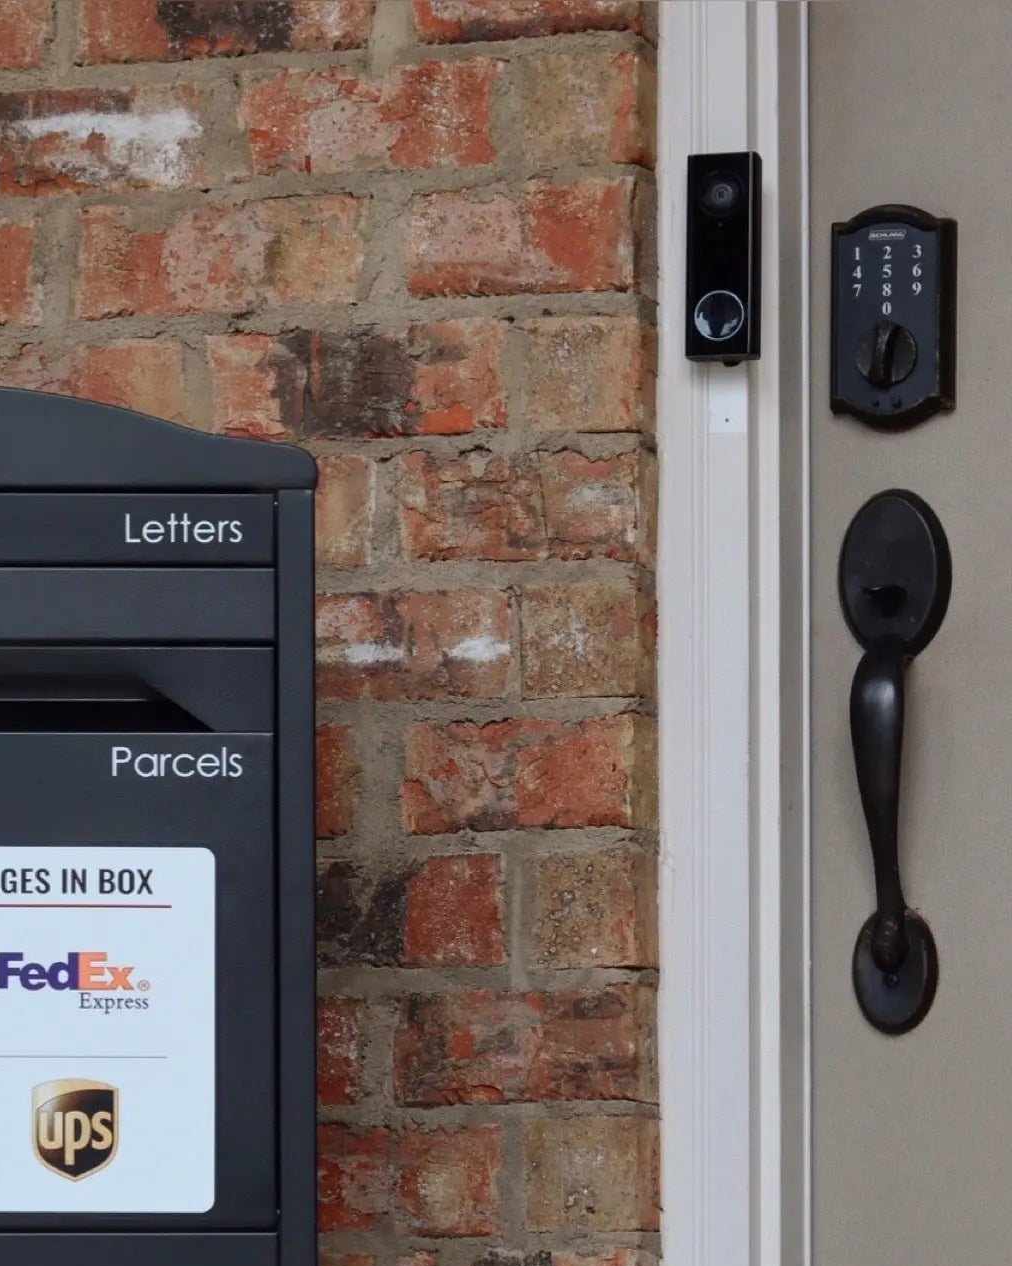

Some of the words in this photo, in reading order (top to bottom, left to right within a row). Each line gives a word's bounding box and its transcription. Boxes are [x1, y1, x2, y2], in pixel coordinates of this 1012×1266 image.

[855, 247, 860, 260] 1
[882, 246, 892, 259] 2
[912, 244, 922, 259] 3
[852, 265, 862, 279] 4
[882, 264, 892, 278] 5
[912, 262, 922, 277] 6
[852, 284, 862, 297] 7
[882, 283, 892, 296] 8
[912, 282, 922, 296] 9
[882, 302, 892, 315] 0
[124, 513, 243, 543] Letters
[111, 747, 243, 778] Parcels
[61, 868, 88, 895] IN
[98, 869, 154, 895] BOX
[78, 992, 149, 1014] Express
[38, 1111, 113, 1166] ups
